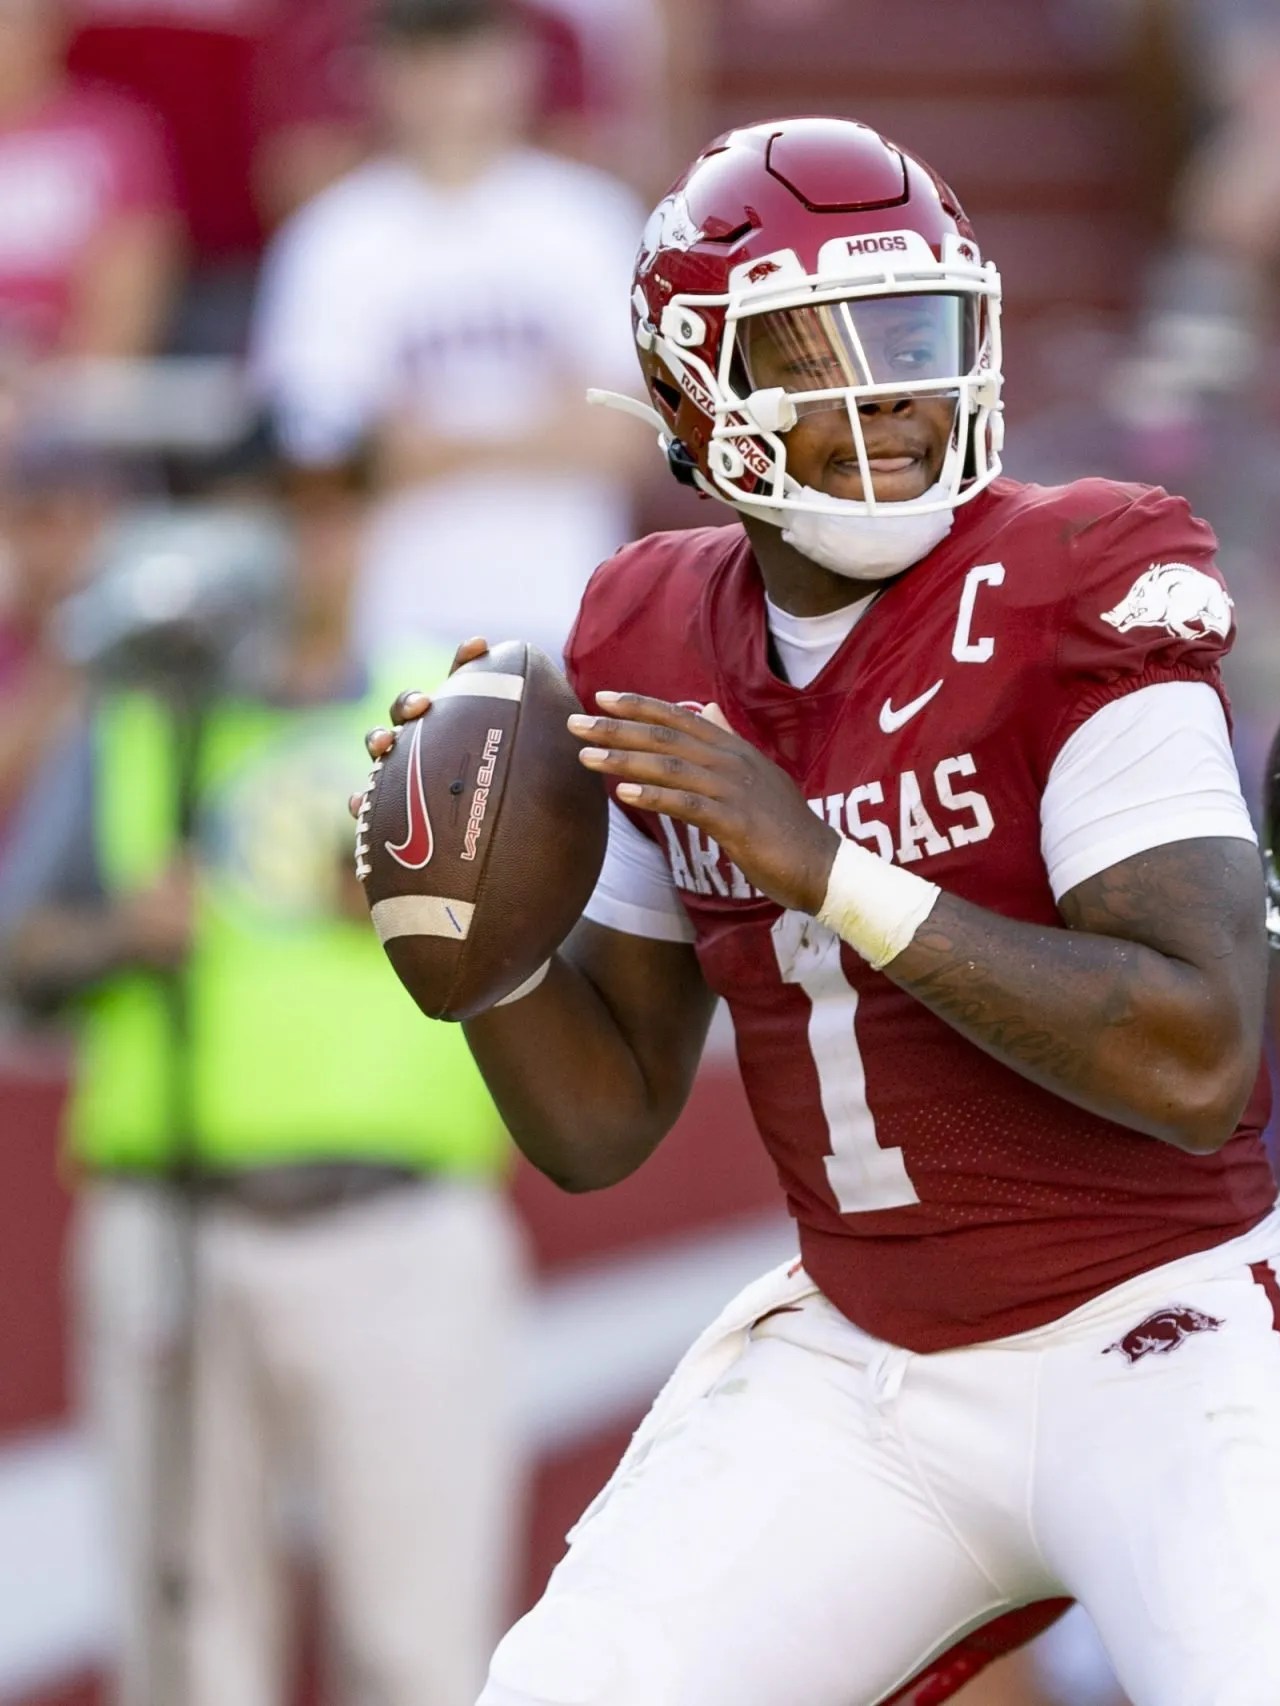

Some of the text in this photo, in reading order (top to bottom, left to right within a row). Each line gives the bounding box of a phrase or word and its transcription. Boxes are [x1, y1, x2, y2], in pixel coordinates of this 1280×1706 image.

[846, 236, 907, 256] HOGS
[951, 562, 1005, 662] C
[460, 728, 502, 861] VAPOR ELITE
[771, 909, 921, 1214] 1
